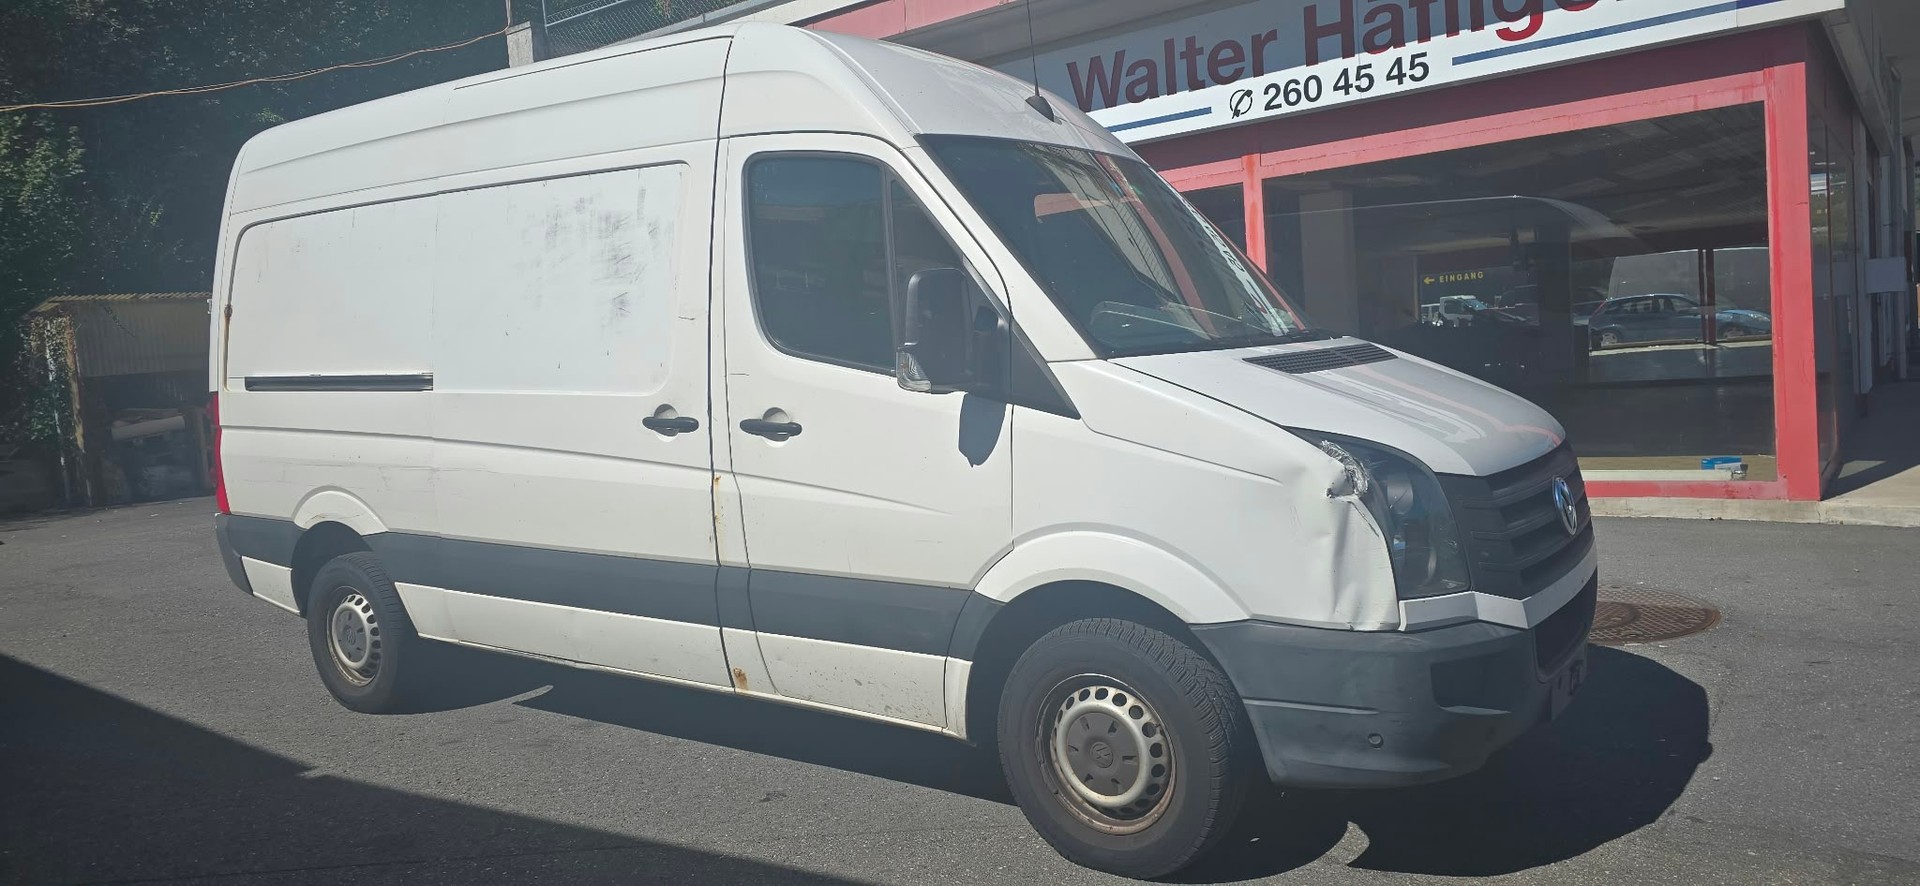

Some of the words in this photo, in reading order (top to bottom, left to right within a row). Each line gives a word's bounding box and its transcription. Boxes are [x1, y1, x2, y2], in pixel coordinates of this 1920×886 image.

[1066, 29, 1278, 112] Walter
[1303, 0, 1625, 67] Häflg
[1263, 75, 1322, 111] 260
[1333, 63, 1375, 96] 45
[1386, 51, 1430, 86] 45
[1439, 271, 1484, 283] EINGANG
